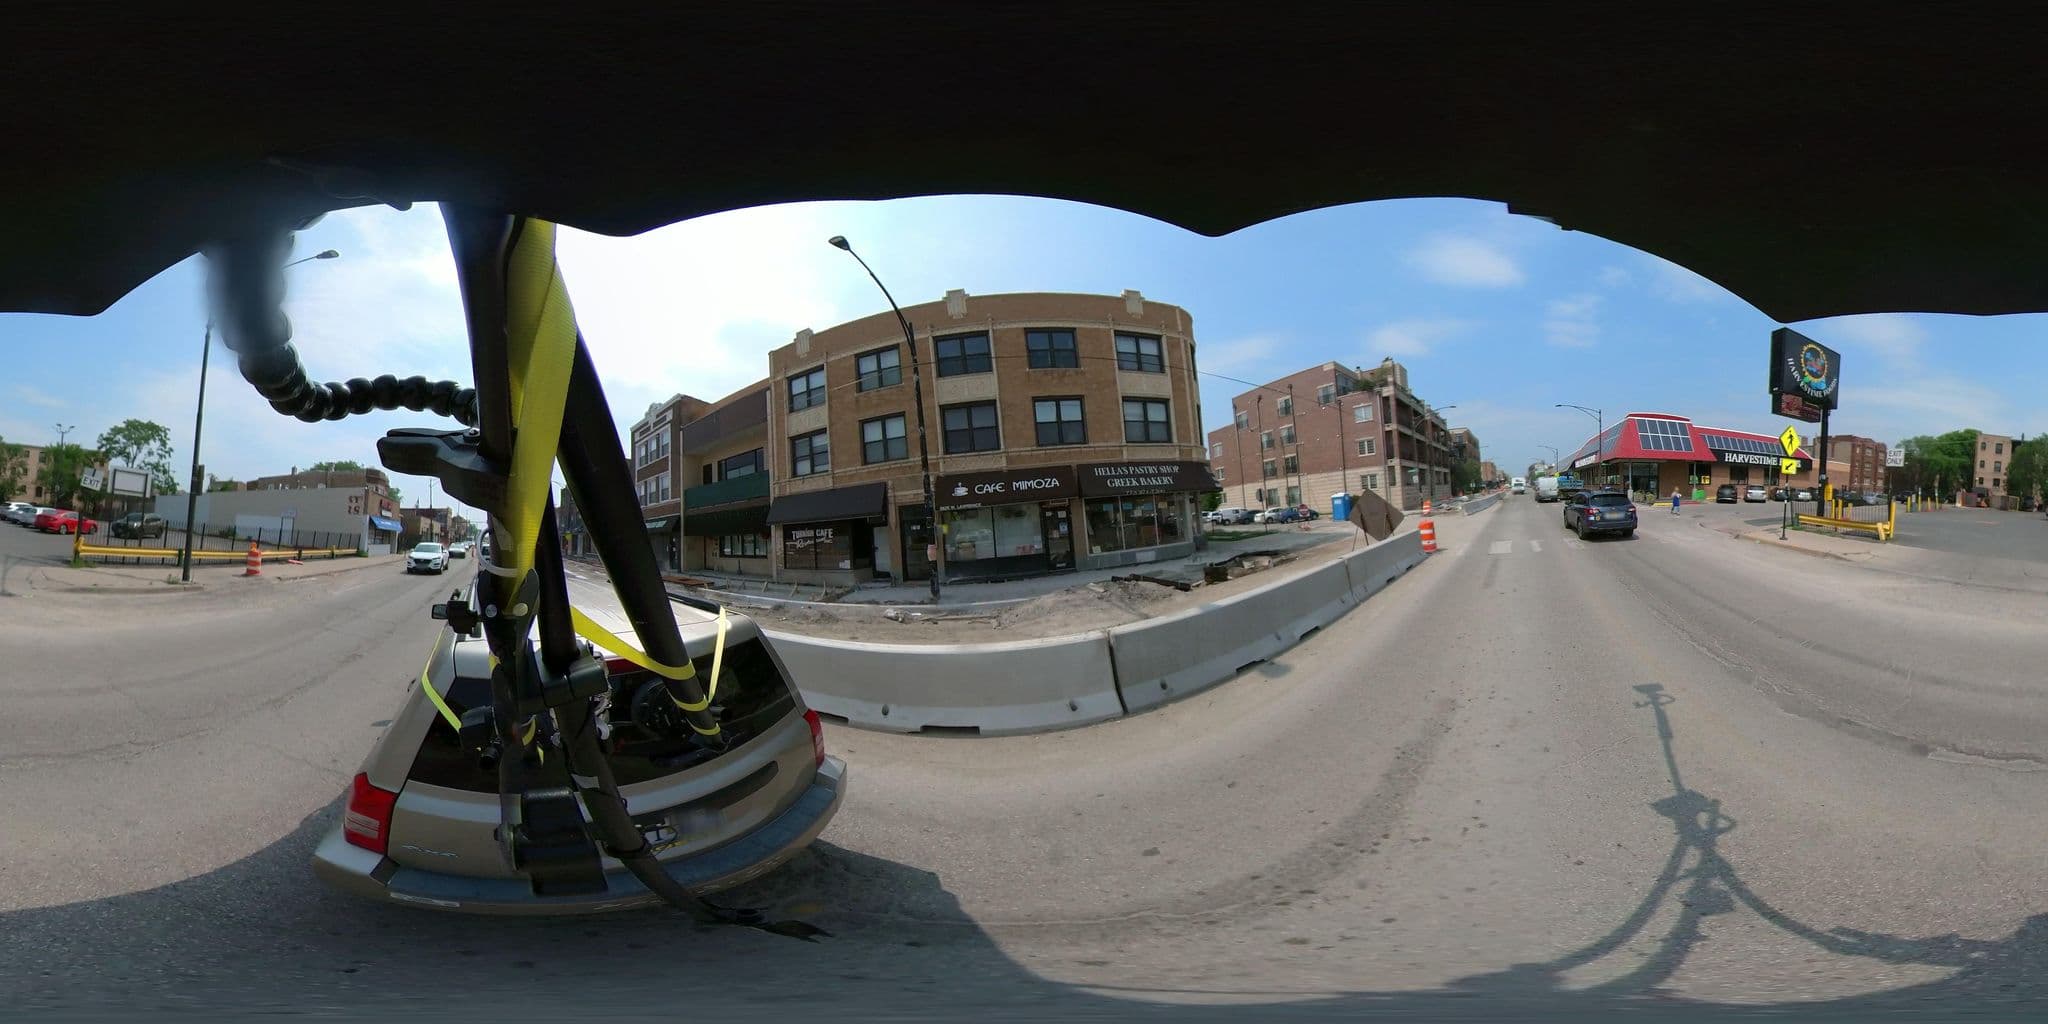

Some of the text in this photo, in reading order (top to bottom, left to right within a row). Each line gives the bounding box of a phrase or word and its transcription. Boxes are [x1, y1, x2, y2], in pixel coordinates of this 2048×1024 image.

[1725, 452, 1778, 466] HARVESTIME
[1887, 457, 1903, 465] ONLY
[1094, 465, 1180, 476] HELLA'S PASTRY SHOP
[82, 475, 101, 488] EXIT
[1012, 478, 1060, 491] MIMOZA
[1107, 476, 1174, 488] GREEK BAKERY
[815, 528, 834, 539] CAFE
